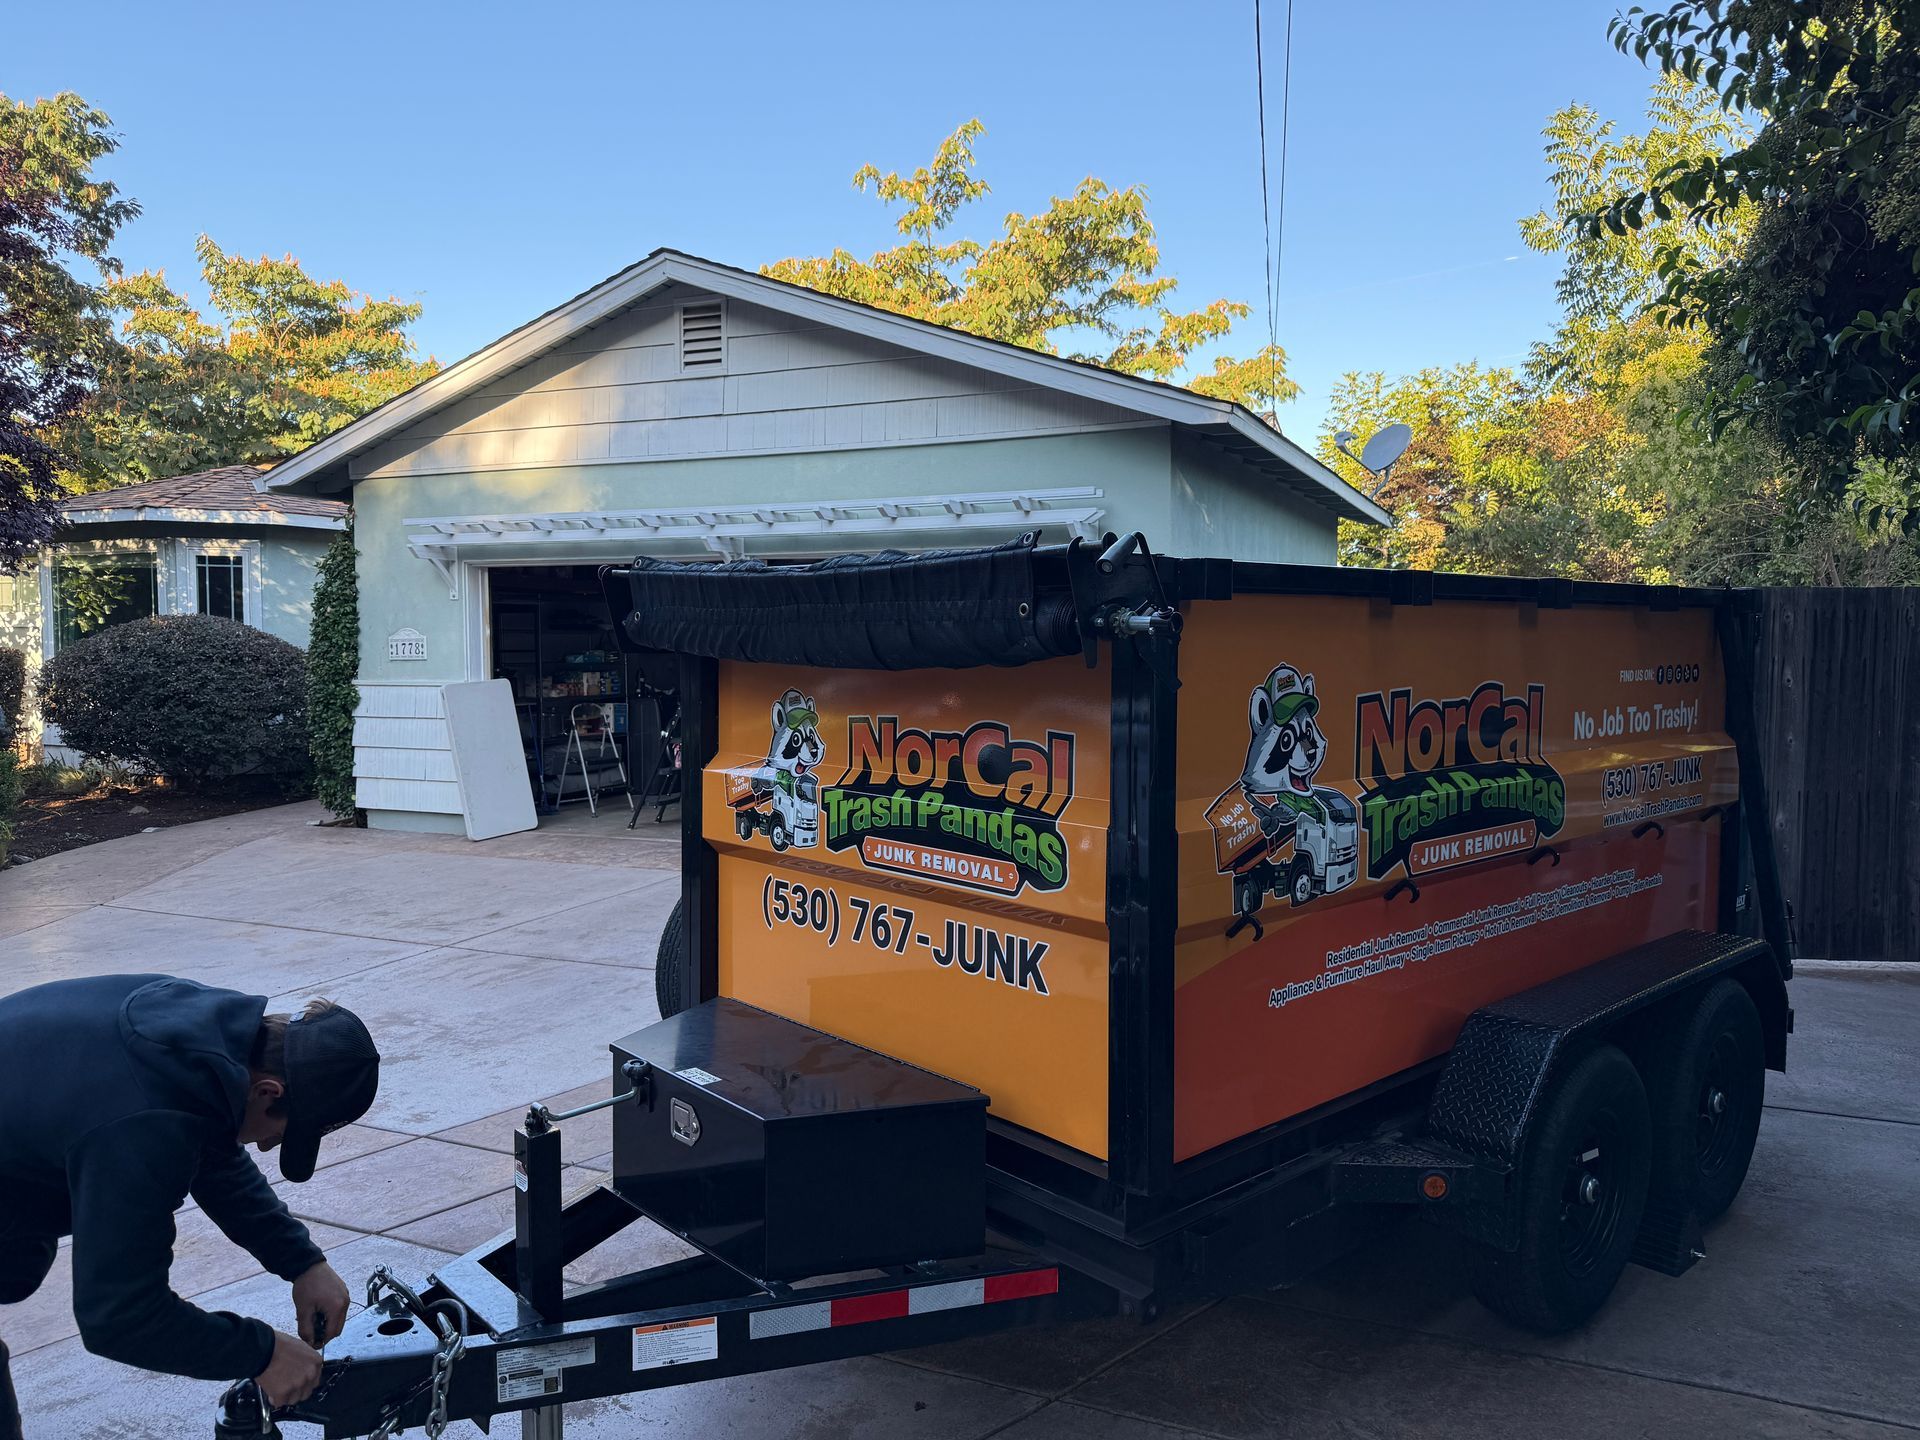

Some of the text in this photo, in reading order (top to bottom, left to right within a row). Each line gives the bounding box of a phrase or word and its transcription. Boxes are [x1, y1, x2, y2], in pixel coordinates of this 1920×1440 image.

[395, 642, 421, 656] 1778
[1619, 669, 1634, 683] FIND
[1635, 669, 1644, 681] US
[1358, 683, 1545, 790] NorCal
[1574, 699, 1698, 740] No Job Too Trashy!
[842, 716, 1074, 815] NorCal
[1601, 755, 1703, 808] (530) 767-JUNK
[1220, 803, 1244, 827] No Job
[1232, 817, 1248, 833] Too
[1603, 794, 1703, 828] www.NorCalTrashPandas.com
[1227, 821, 1257, 848] Trashy
[1420, 827, 1527, 866] JUNK REMOVAL
[873, 843, 1004, 883] JUNK REMOVAL
[762, 874, 1050, 995] (530) 767-JUNK
[1326, 941, 1374, 968] Residential
[1375, 937, 1395, 956] Junk
[1395, 923, 1427, 948] Removal
[1433, 911, 1475, 936] Commercial
[1475, 905, 1493, 925] Junk
[1493, 897, 1520, 918] Removal
[1524, 895, 1537, 910] Full
[1536, 888, 1561, 908] Property
[1560, 881, 1588, 899] Cleanouts
[1591, 872, 1612, 890] Hoarder
[1269, 980, 1314, 1008] Appliance
[1315, 976, 1323, 991] &
[1323, 964, 1363, 988] Furniture
[1363, 958, 1383, 978] Haul
[1383, 952, 1405, 974] Away
[1409, 942, 1434, 963] Single
[1433, 936, 1451, 956] Item
[1451, 929, 1480, 950] Pickups
[1484, 923, 1499, 939] Hot
[1498, 919, 1511, 934] Tub
[1511, 910, 1537, 931] Removal
[1541, 906, 1556, 921] Shed
[1555, 898, 1585, 916] Demolition
[1590, 887, 1612, 904] Removal
